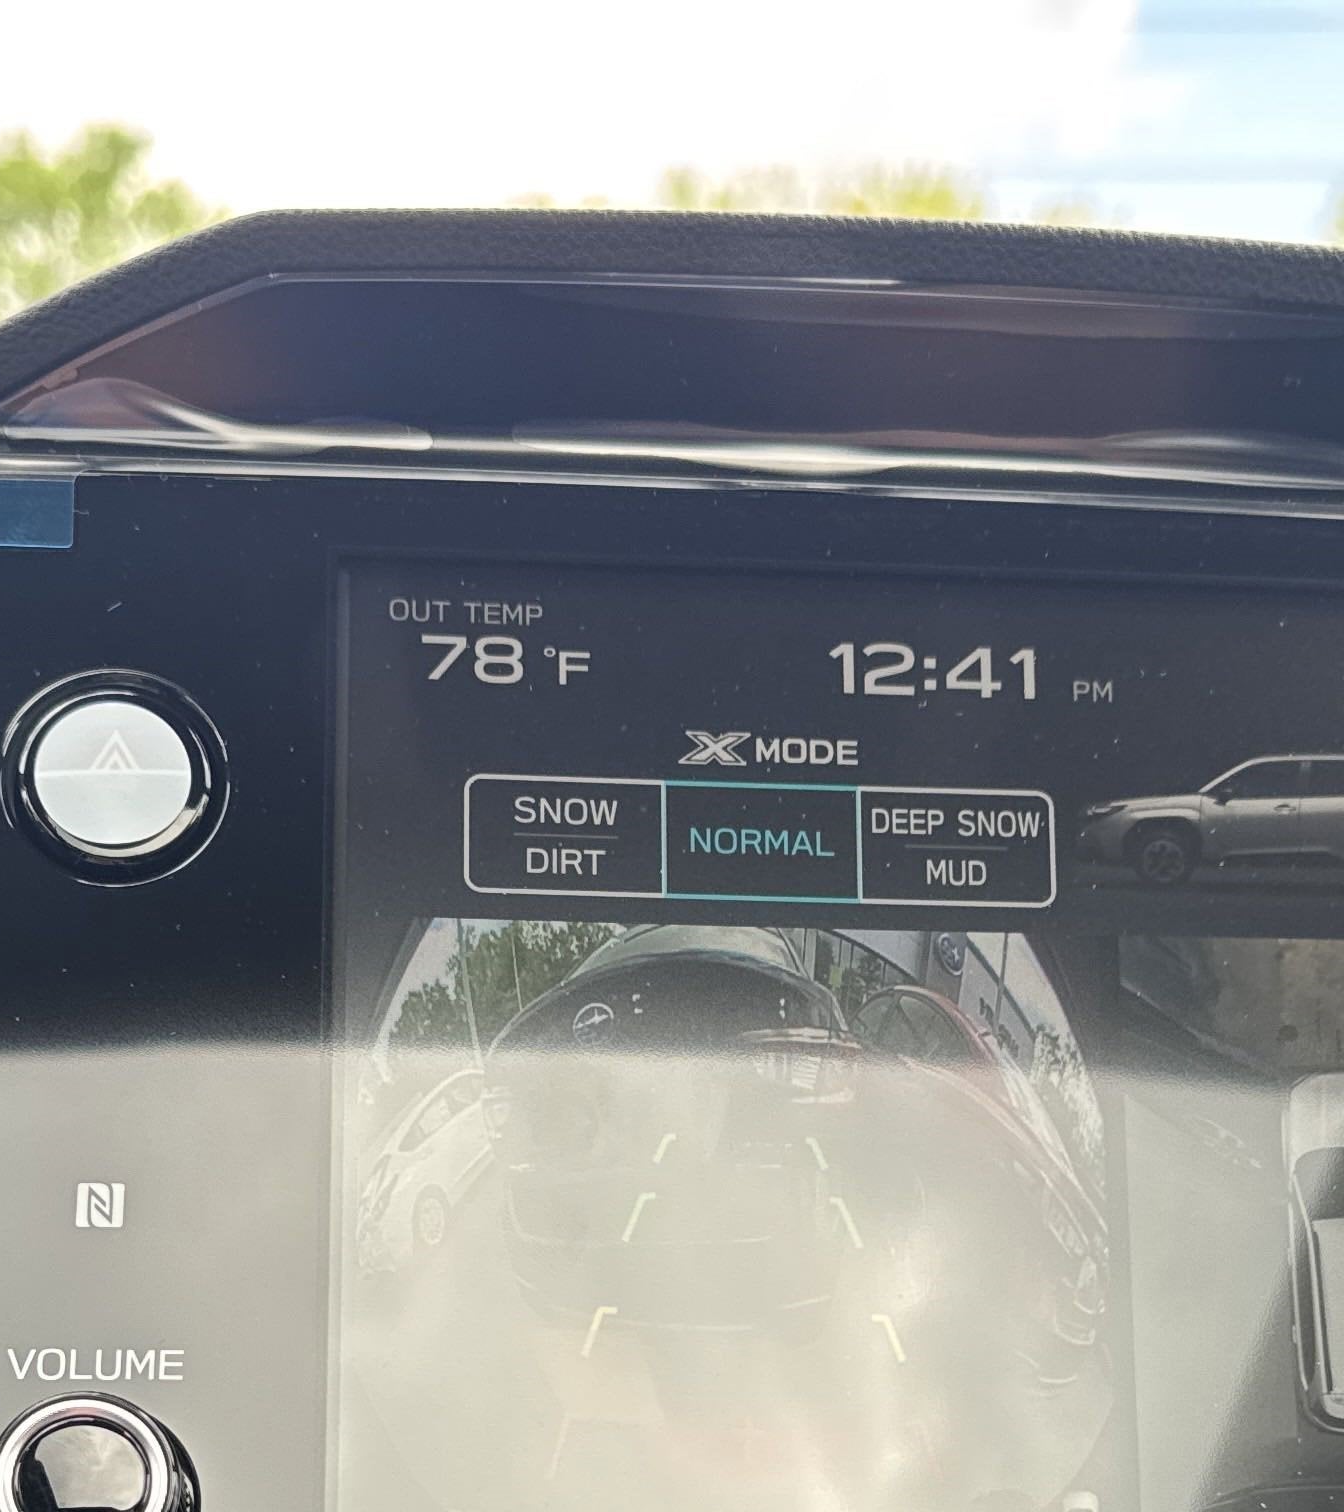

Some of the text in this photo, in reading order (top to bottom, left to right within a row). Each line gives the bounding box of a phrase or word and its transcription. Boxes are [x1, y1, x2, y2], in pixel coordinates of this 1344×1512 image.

[388, 598, 543, 626] OUT TEMP
[420, 634, 524, 684] 78
[828, 641, 1114, 703] 12:41 PM
[755, 737, 859, 766] MODE
[513, 796, 618, 826] SNOW
[870, 807, 1040, 838] DEEP SNOW
[689, 826, 835, 857] NORMAL
[525, 848, 606, 876] DIRT
[926, 858, 987, 887] MUD
[7, 1348, 185, 1381] VOLUME
